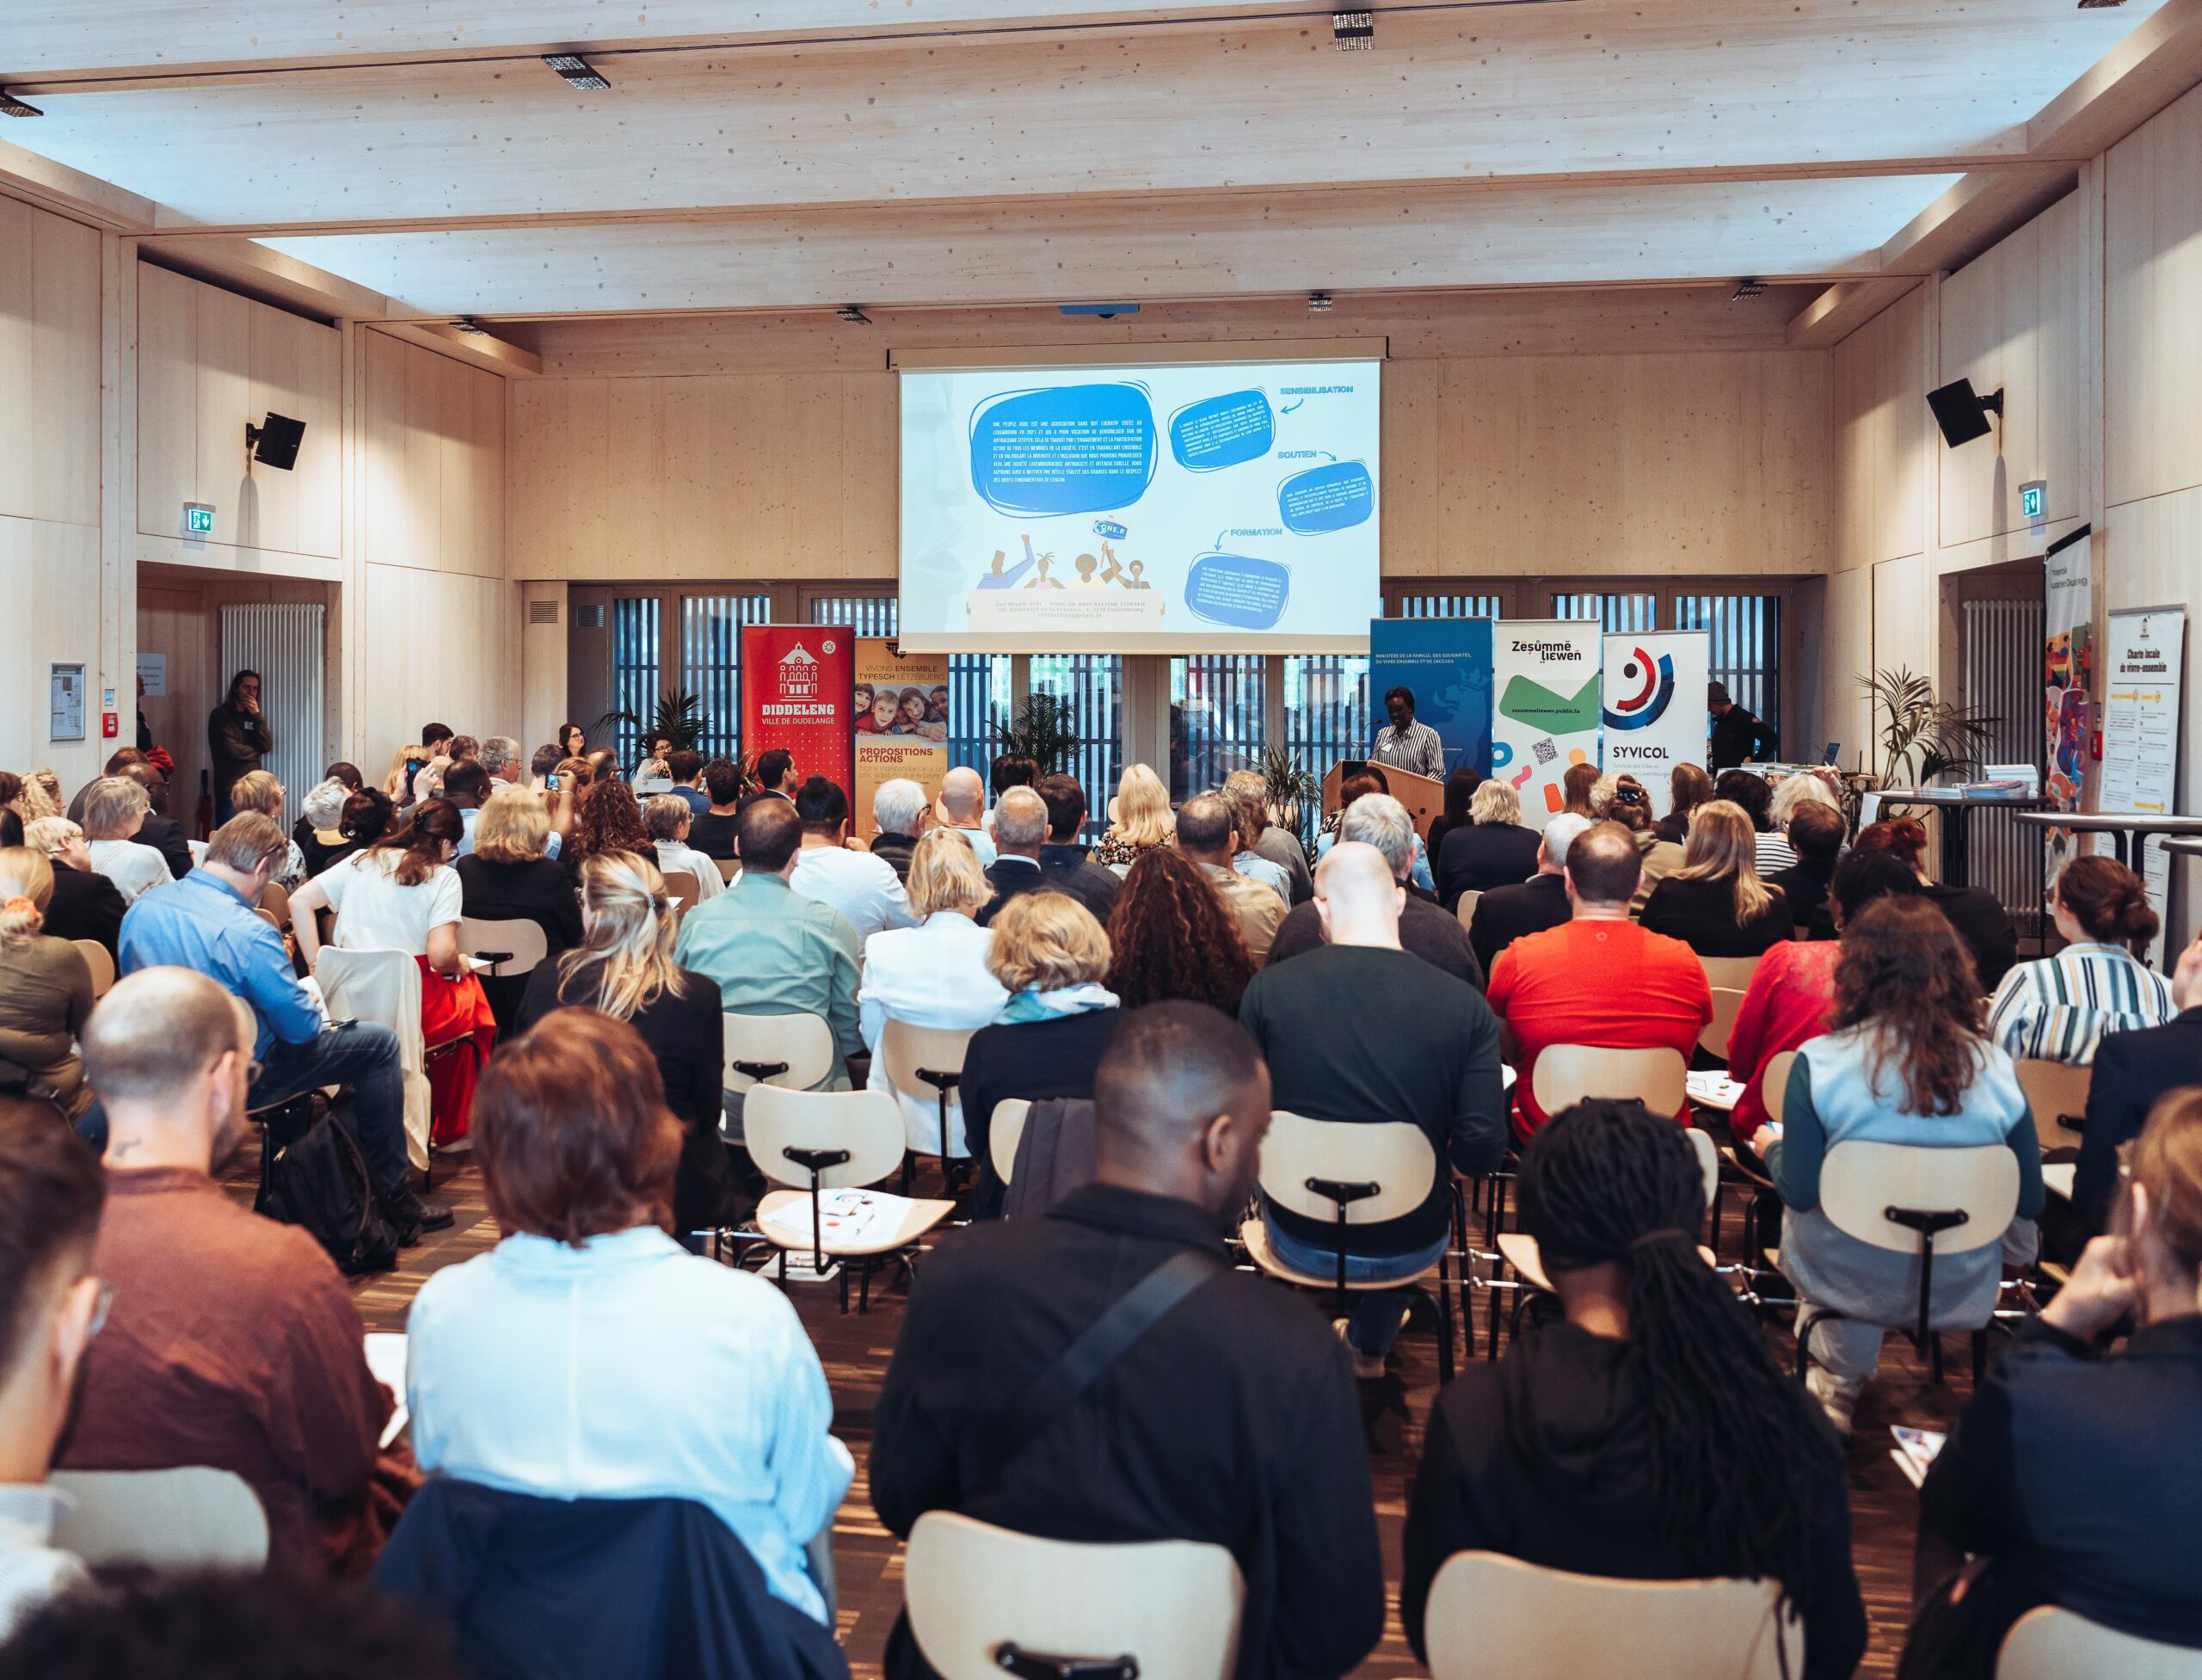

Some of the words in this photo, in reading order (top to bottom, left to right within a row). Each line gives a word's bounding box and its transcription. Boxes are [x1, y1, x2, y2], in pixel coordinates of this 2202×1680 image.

[1280, 386, 1353, 394] SENSIBILISATION
[1230, 528, 1282, 536] FORMATION
[762, 704, 835, 715] DIDDELENG
[1613, 746, 1669, 759] SYVICOL
